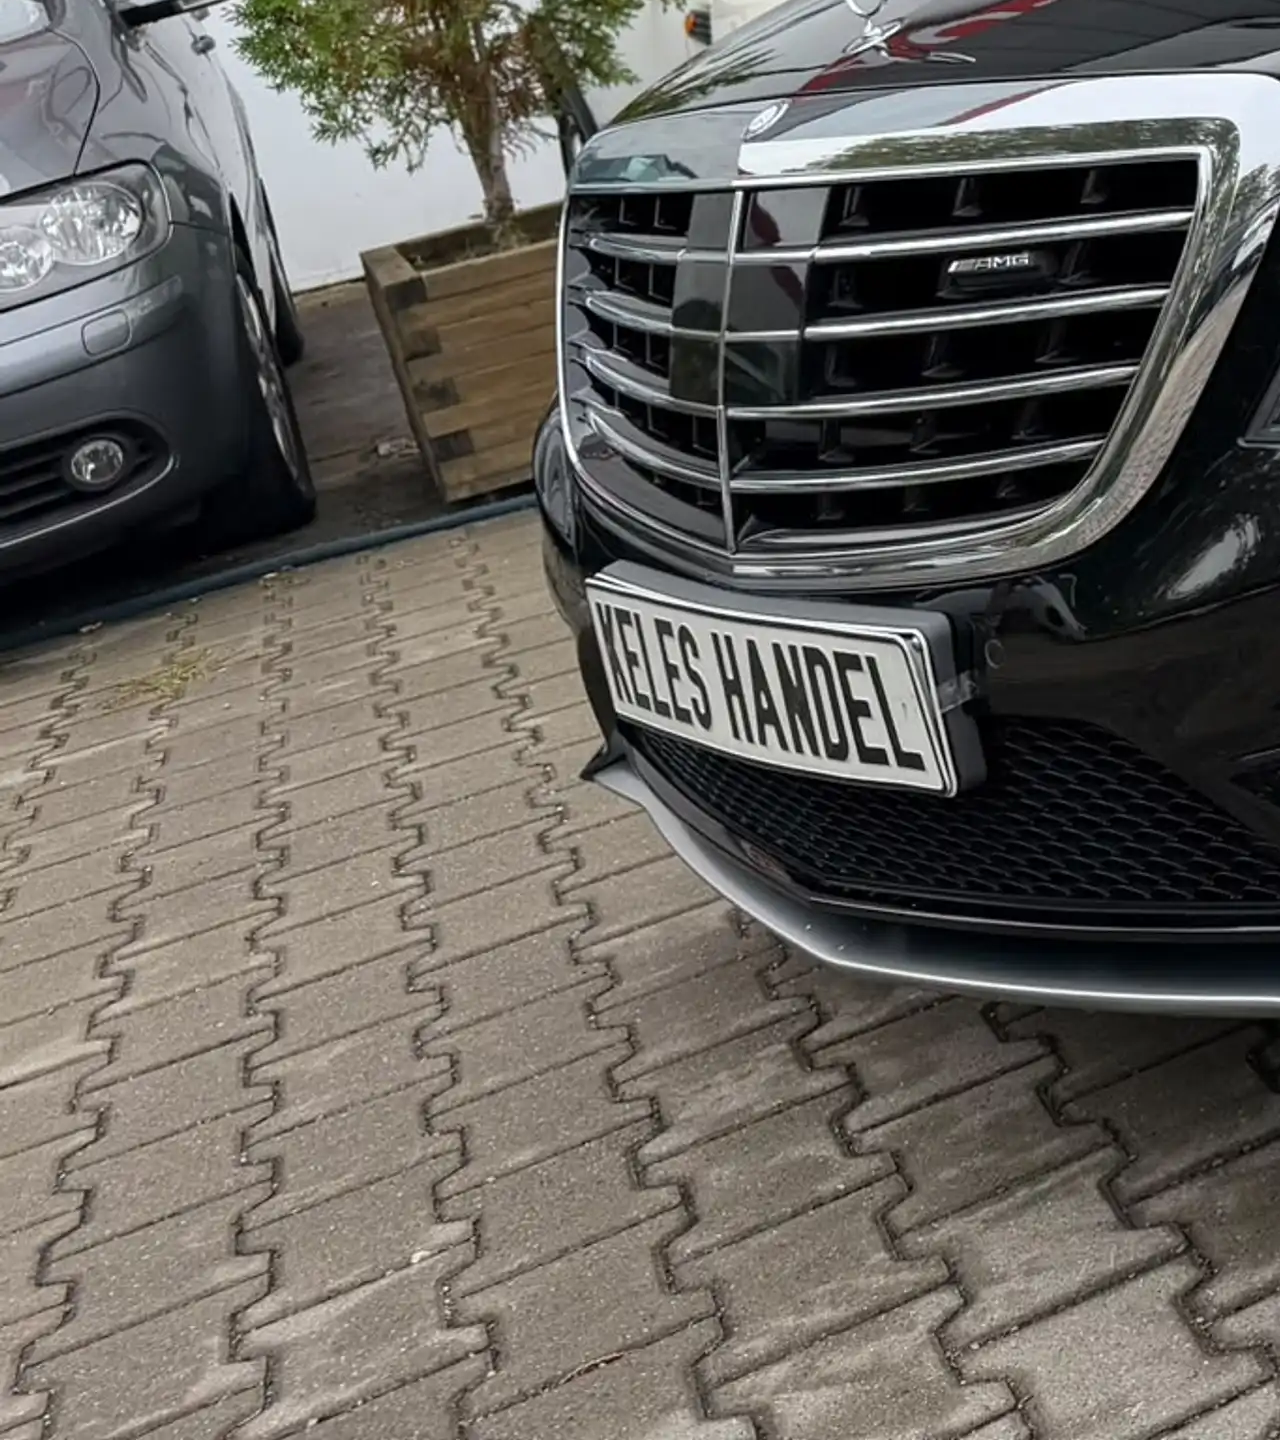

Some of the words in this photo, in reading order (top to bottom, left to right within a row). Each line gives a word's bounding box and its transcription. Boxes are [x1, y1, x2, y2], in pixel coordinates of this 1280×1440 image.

[974, 253, 1029, 270] AMG
[596, 602, 712, 731] KELES
[712, 631, 925, 771] HANDEL
